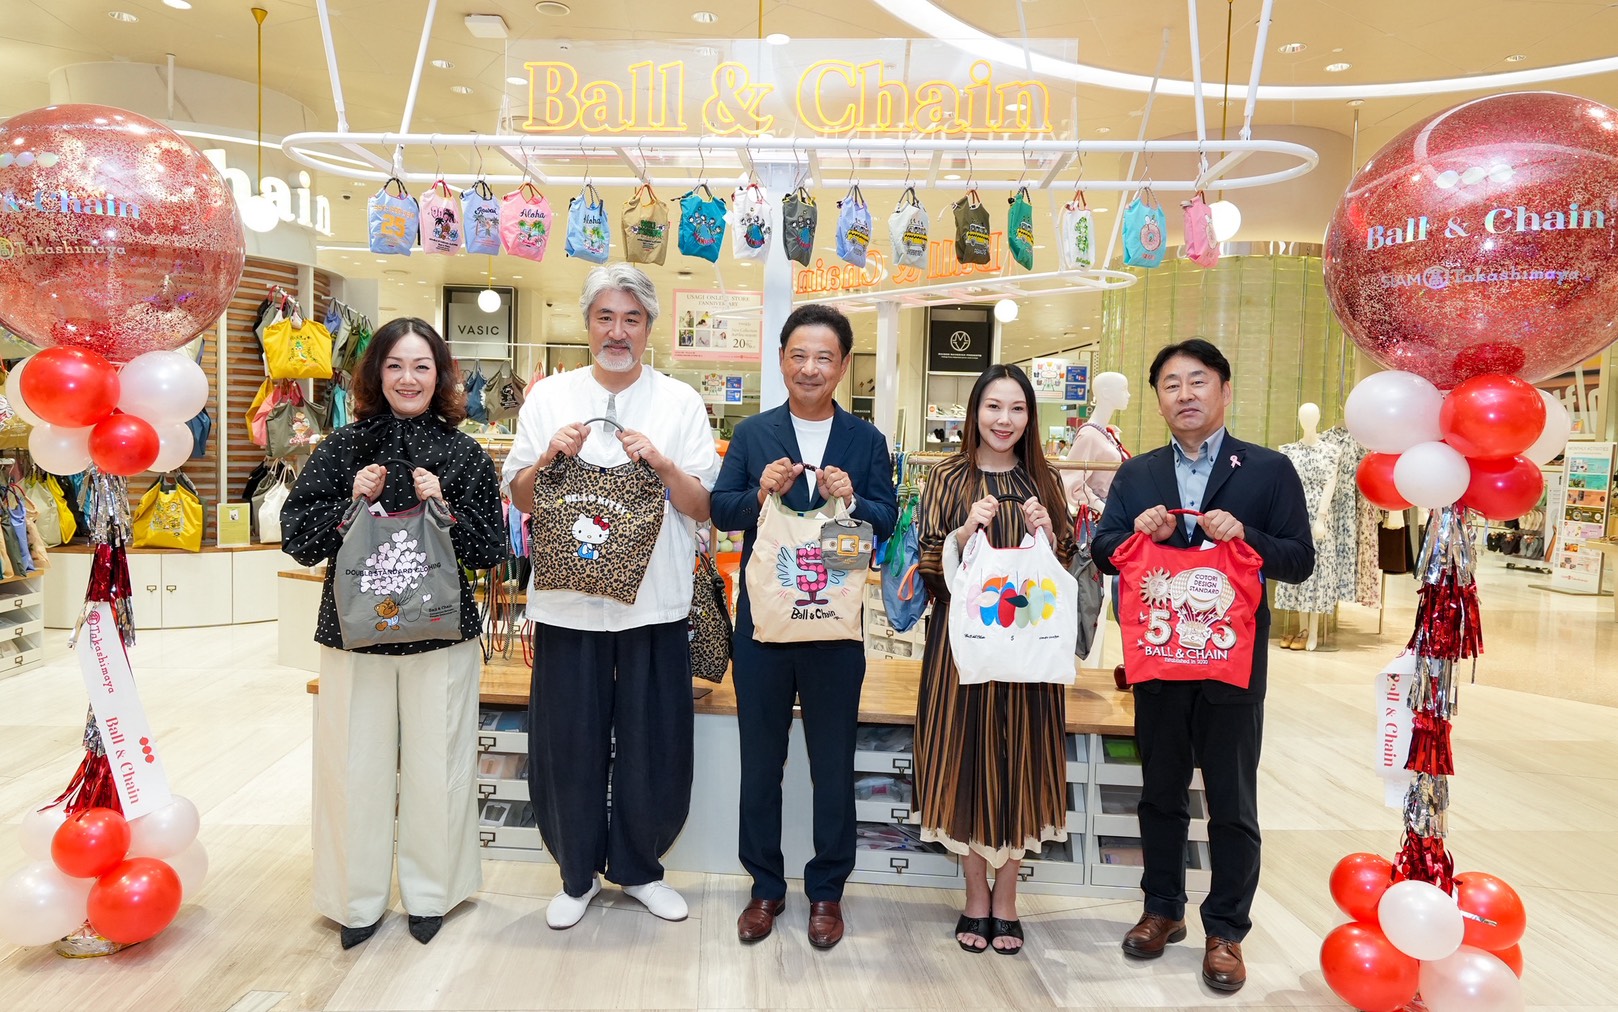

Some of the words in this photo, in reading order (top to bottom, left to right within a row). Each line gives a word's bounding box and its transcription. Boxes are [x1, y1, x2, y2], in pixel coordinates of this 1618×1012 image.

[522, 59, 688, 133] Ball
[702, 60, 775, 135] &
[796, 58, 1054, 134] Chain
[34, 189, 141, 219] Chain
[520, 209, 546, 219] Aloha
[1366, 214, 1429, 251] Ball
[1444, 216, 1471, 239] &
[1484, 202, 1606, 235] Chain
[15, 241, 126, 259] Takashimaya
[1381, 273, 1421, 290] SIAM
[1453, 266, 1581, 286] Takashimaya
[458, 325, 499, 335] VASIC
[565, 494, 596, 503] HELLO
[598, 495, 627, 514] KITTY
[345, 569, 372, 577] DOUBLE
[373, 568, 413, 577] STANDARD
[1189, 586, 1220, 595] STANDARD
[1193, 580, 1218, 588] DESIGN
[791, 607, 808, 620] Ball
[815, 608, 836, 619] Chain
[1144, 609, 1172, 646] 5
[90, 625, 114, 694] Takashimaya
[1145, 646, 1174, 658] BALL
[1175, 648, 1185, 658] &
[1186, 649, 1229, 660] CHAIN
[1385, 707, 1396, 717] &
[105, 717, 125, 745] Ball
[115, 749, 126, 759] &
[1383, 723, 1398, 767] Chain
[120, 761, 140, 805] Chain
